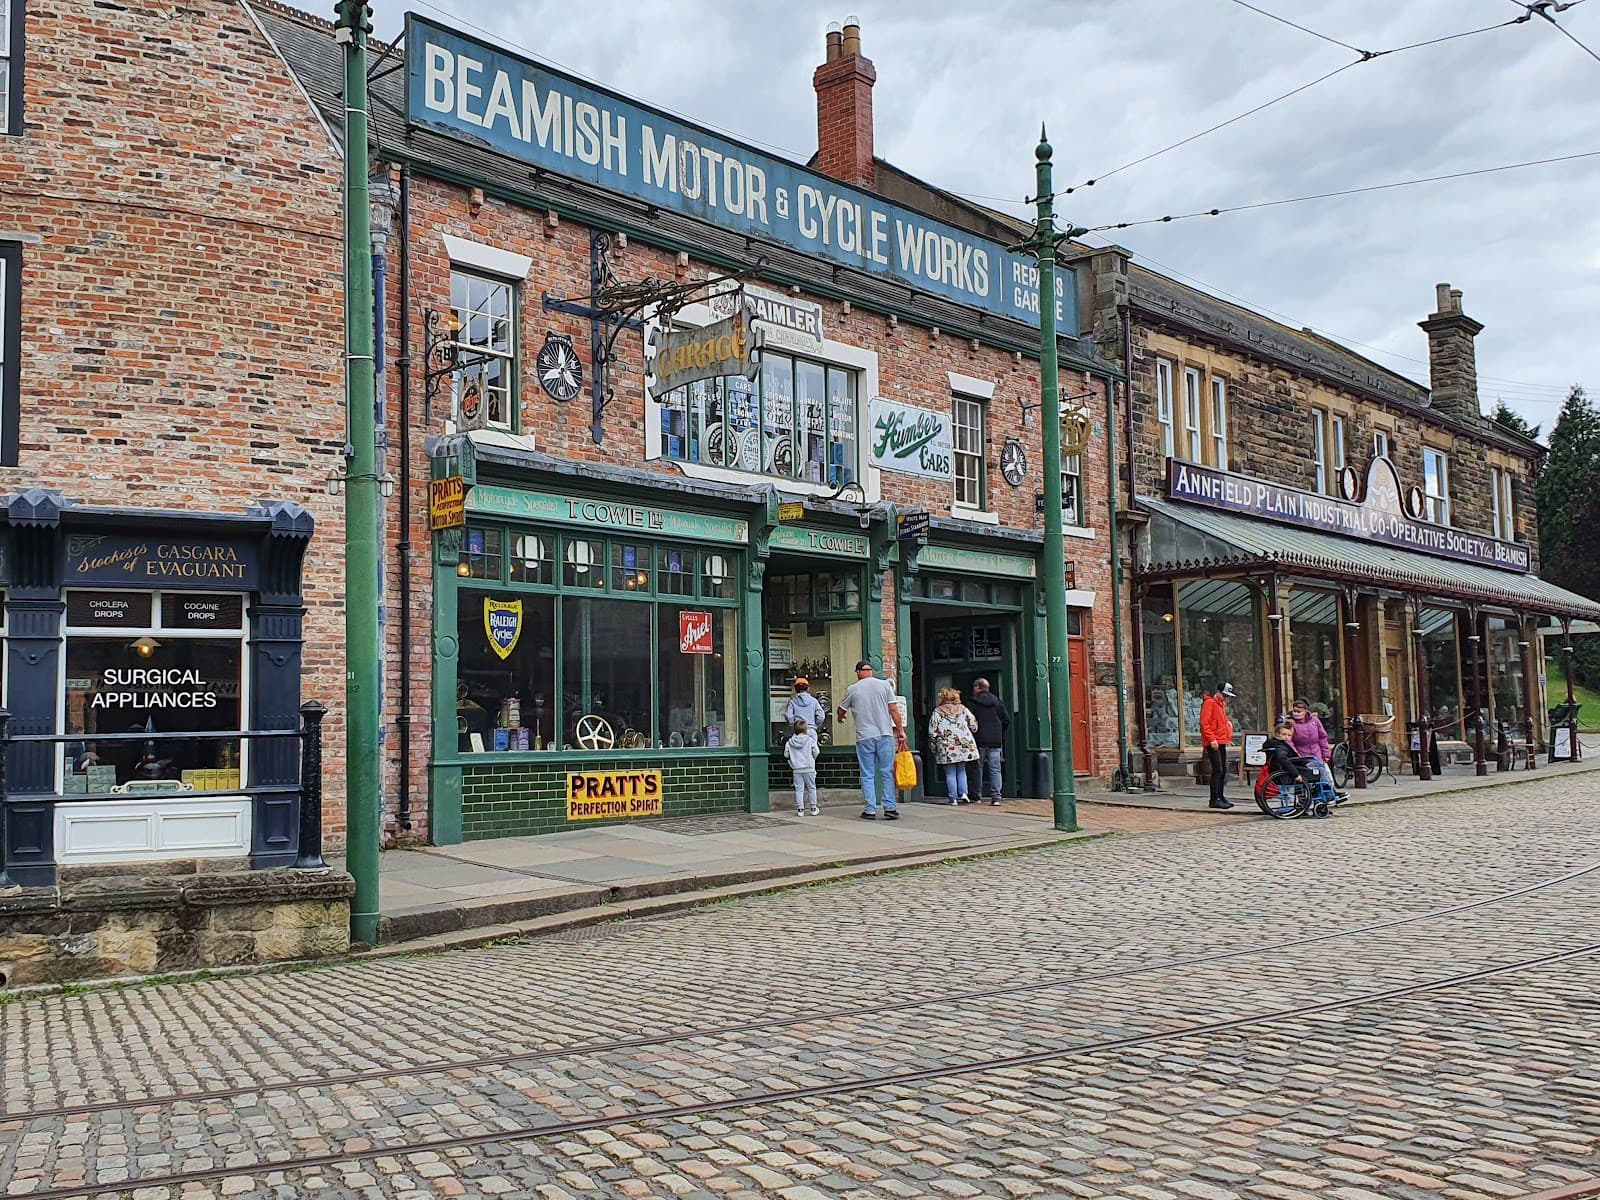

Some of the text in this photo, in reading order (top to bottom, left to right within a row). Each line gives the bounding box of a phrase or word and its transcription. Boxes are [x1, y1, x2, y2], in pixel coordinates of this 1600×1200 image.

[425, 42, 989, 297] BEAMISH MOTOR & CYCLE WORKS
[1013, 261, 1063, 297] REPS
[1015, 286, 1063, 321] GARE
[658, 326, 748, 379] GARAGE
[873, 411, 941, 458] Humber
[919, 445, 949, 474] CARS
[582, 502, 646, 529] COWIE
[1176, 466, 1251, 506] ANNFIELD
[1255, 484, 1297, 516] PLAIN
[1299, 495, 1367, 532] INDUSTRIAL
[1369, 511, 1445, 549] CO-OPERATIVE
[1446, 530, 1484, 557] SOCIETY
[1494, 542, 1527, 567] BEAMISH
[818, 534, 853, 553] COWIE
[122, 557, 137, 572] of
[94, 610, 124, 618] DROPS
[184, 603, 220, 611] COCAINE
[188, 612, 216, 620] DROPS
[490, 613, 517, 628] RALEIGH
[493, 629, 513, 642] Cycles
[682, 615, 710, 650] Ariel
[104, 669, 206, 685] SURGICAL
[91, 692, 217, 709] APPLIANCES
[571, 774, 658, 799] PRATT'S
[571, 798, 659, 816] PERFECTION SPIRIT
